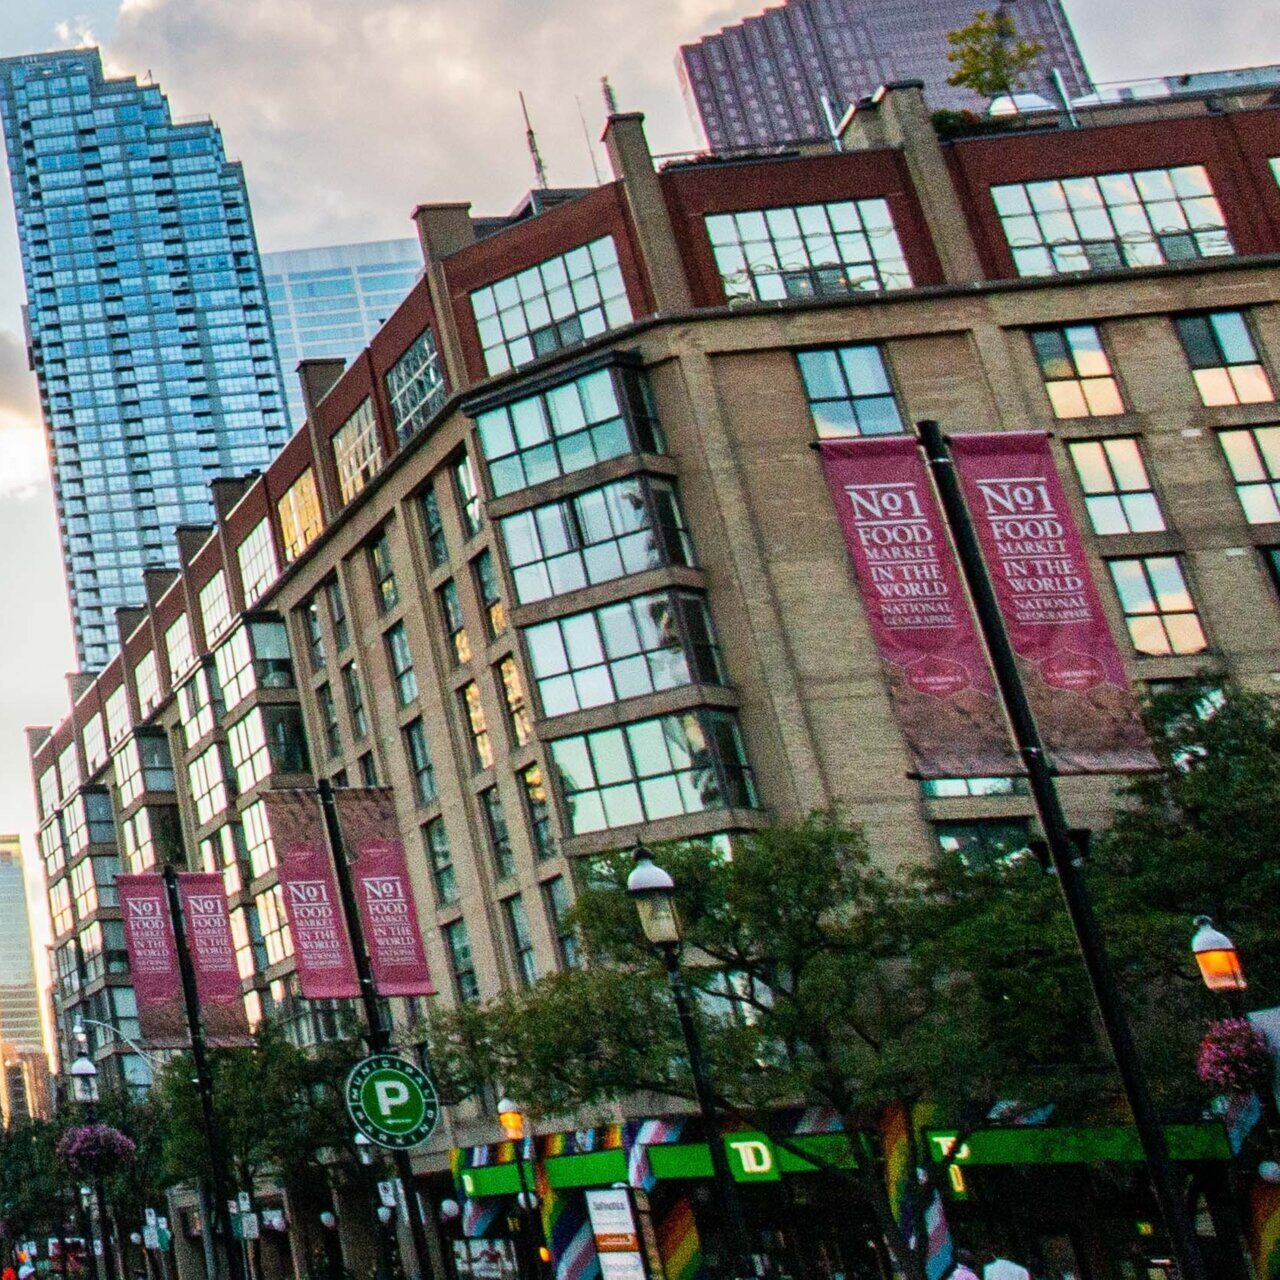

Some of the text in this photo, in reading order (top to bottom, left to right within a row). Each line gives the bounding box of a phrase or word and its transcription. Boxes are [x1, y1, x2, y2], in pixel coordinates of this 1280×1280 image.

[857, 525, 933, 545] FOOD
[990, 520, 1063, 540] FOOD
[864, 545, 937, 559] MARKET
[997, 539, 1066, 554] MARKET
[870, 565, 944, 581] IN THE
[1003, 559, 1076, 576] IN THE
[876, 582, 948, 598] WORLD
[1008, 576, 1083, 592] WORLD
[881, 601, 953, 614] NATIONAL
[1014, 596, 1088, 610] NATIONAL
[293, 906, 333, 918] FOOD
[367, 902, 408, 915] FOOD
[130, 919, 164, 930] FOOD
[192, 918, 226, 928] FOOD
[296, 919, 333, 927] MARKET
[370, 915, 408, 923] MARKET
[298, 930, 338, 940] IN THE
[373, 926, 413, 936] IN THE
[300, 940, 339, 950] WORLD
[375, 937, 415, 946] WORLD
[351, 1060, 430, 1100] MUNICIPAL
[375, 1081, 409, 1115] P
[356, 1109, 434, 1144] PARKING
[730, 1141, 771, 1173] TD
